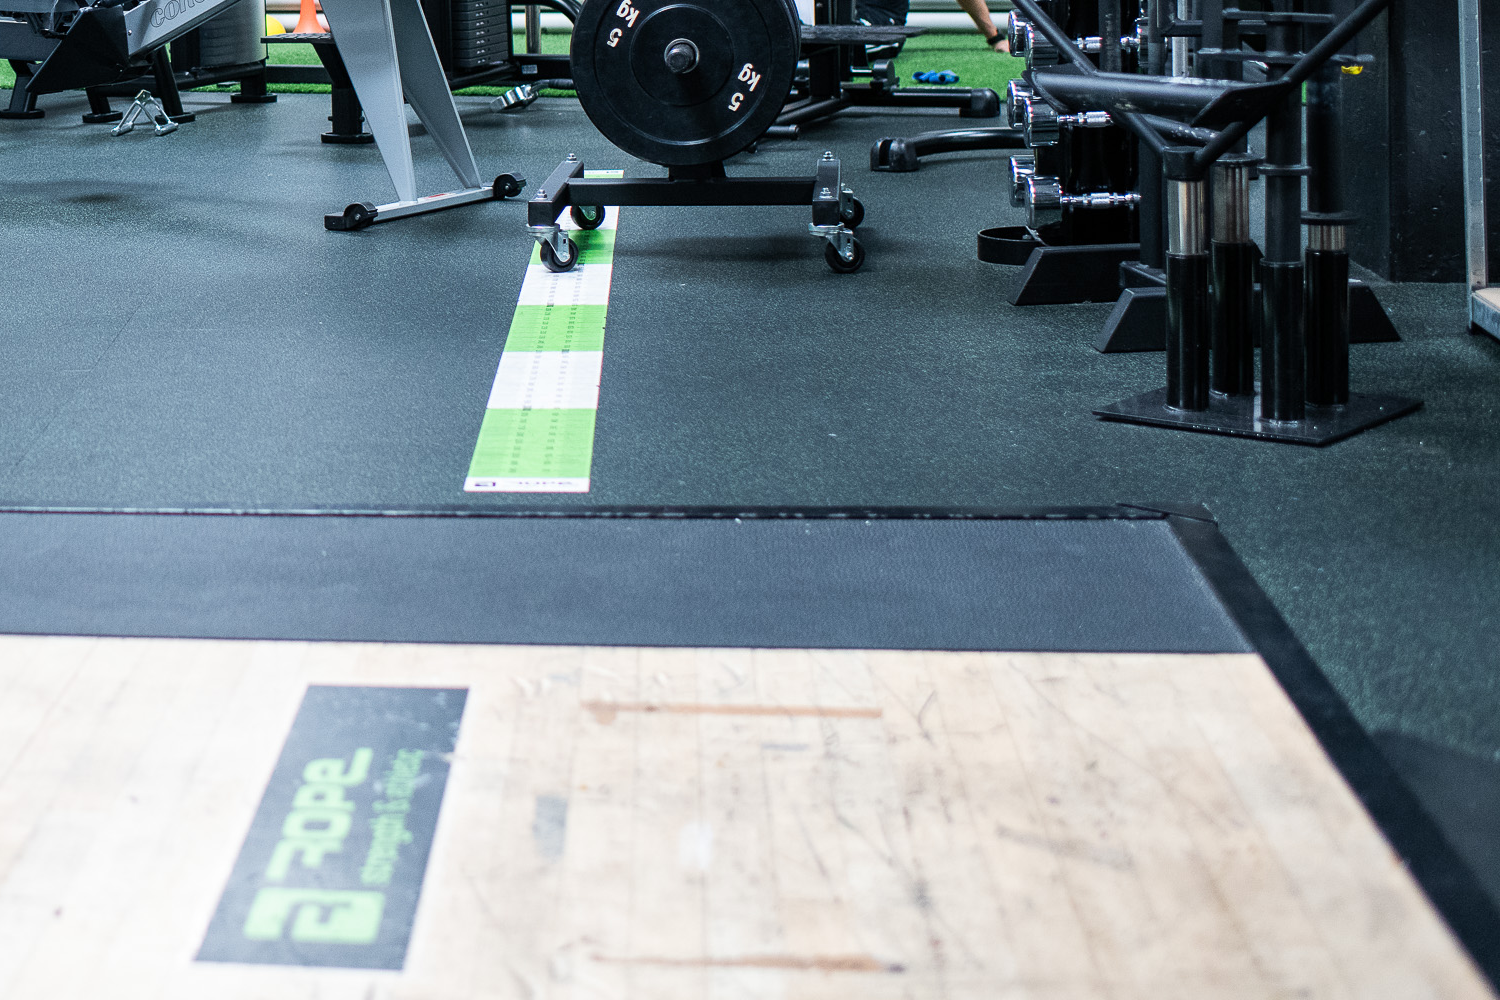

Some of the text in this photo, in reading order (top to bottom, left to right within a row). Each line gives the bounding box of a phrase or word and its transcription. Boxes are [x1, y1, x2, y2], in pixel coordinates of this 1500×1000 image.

[616, 0, 640, 28] kg
[606, 28, 623, 48] 5
[737, 63, 761, 92] kg
[727, 91, 744, 112] 5
